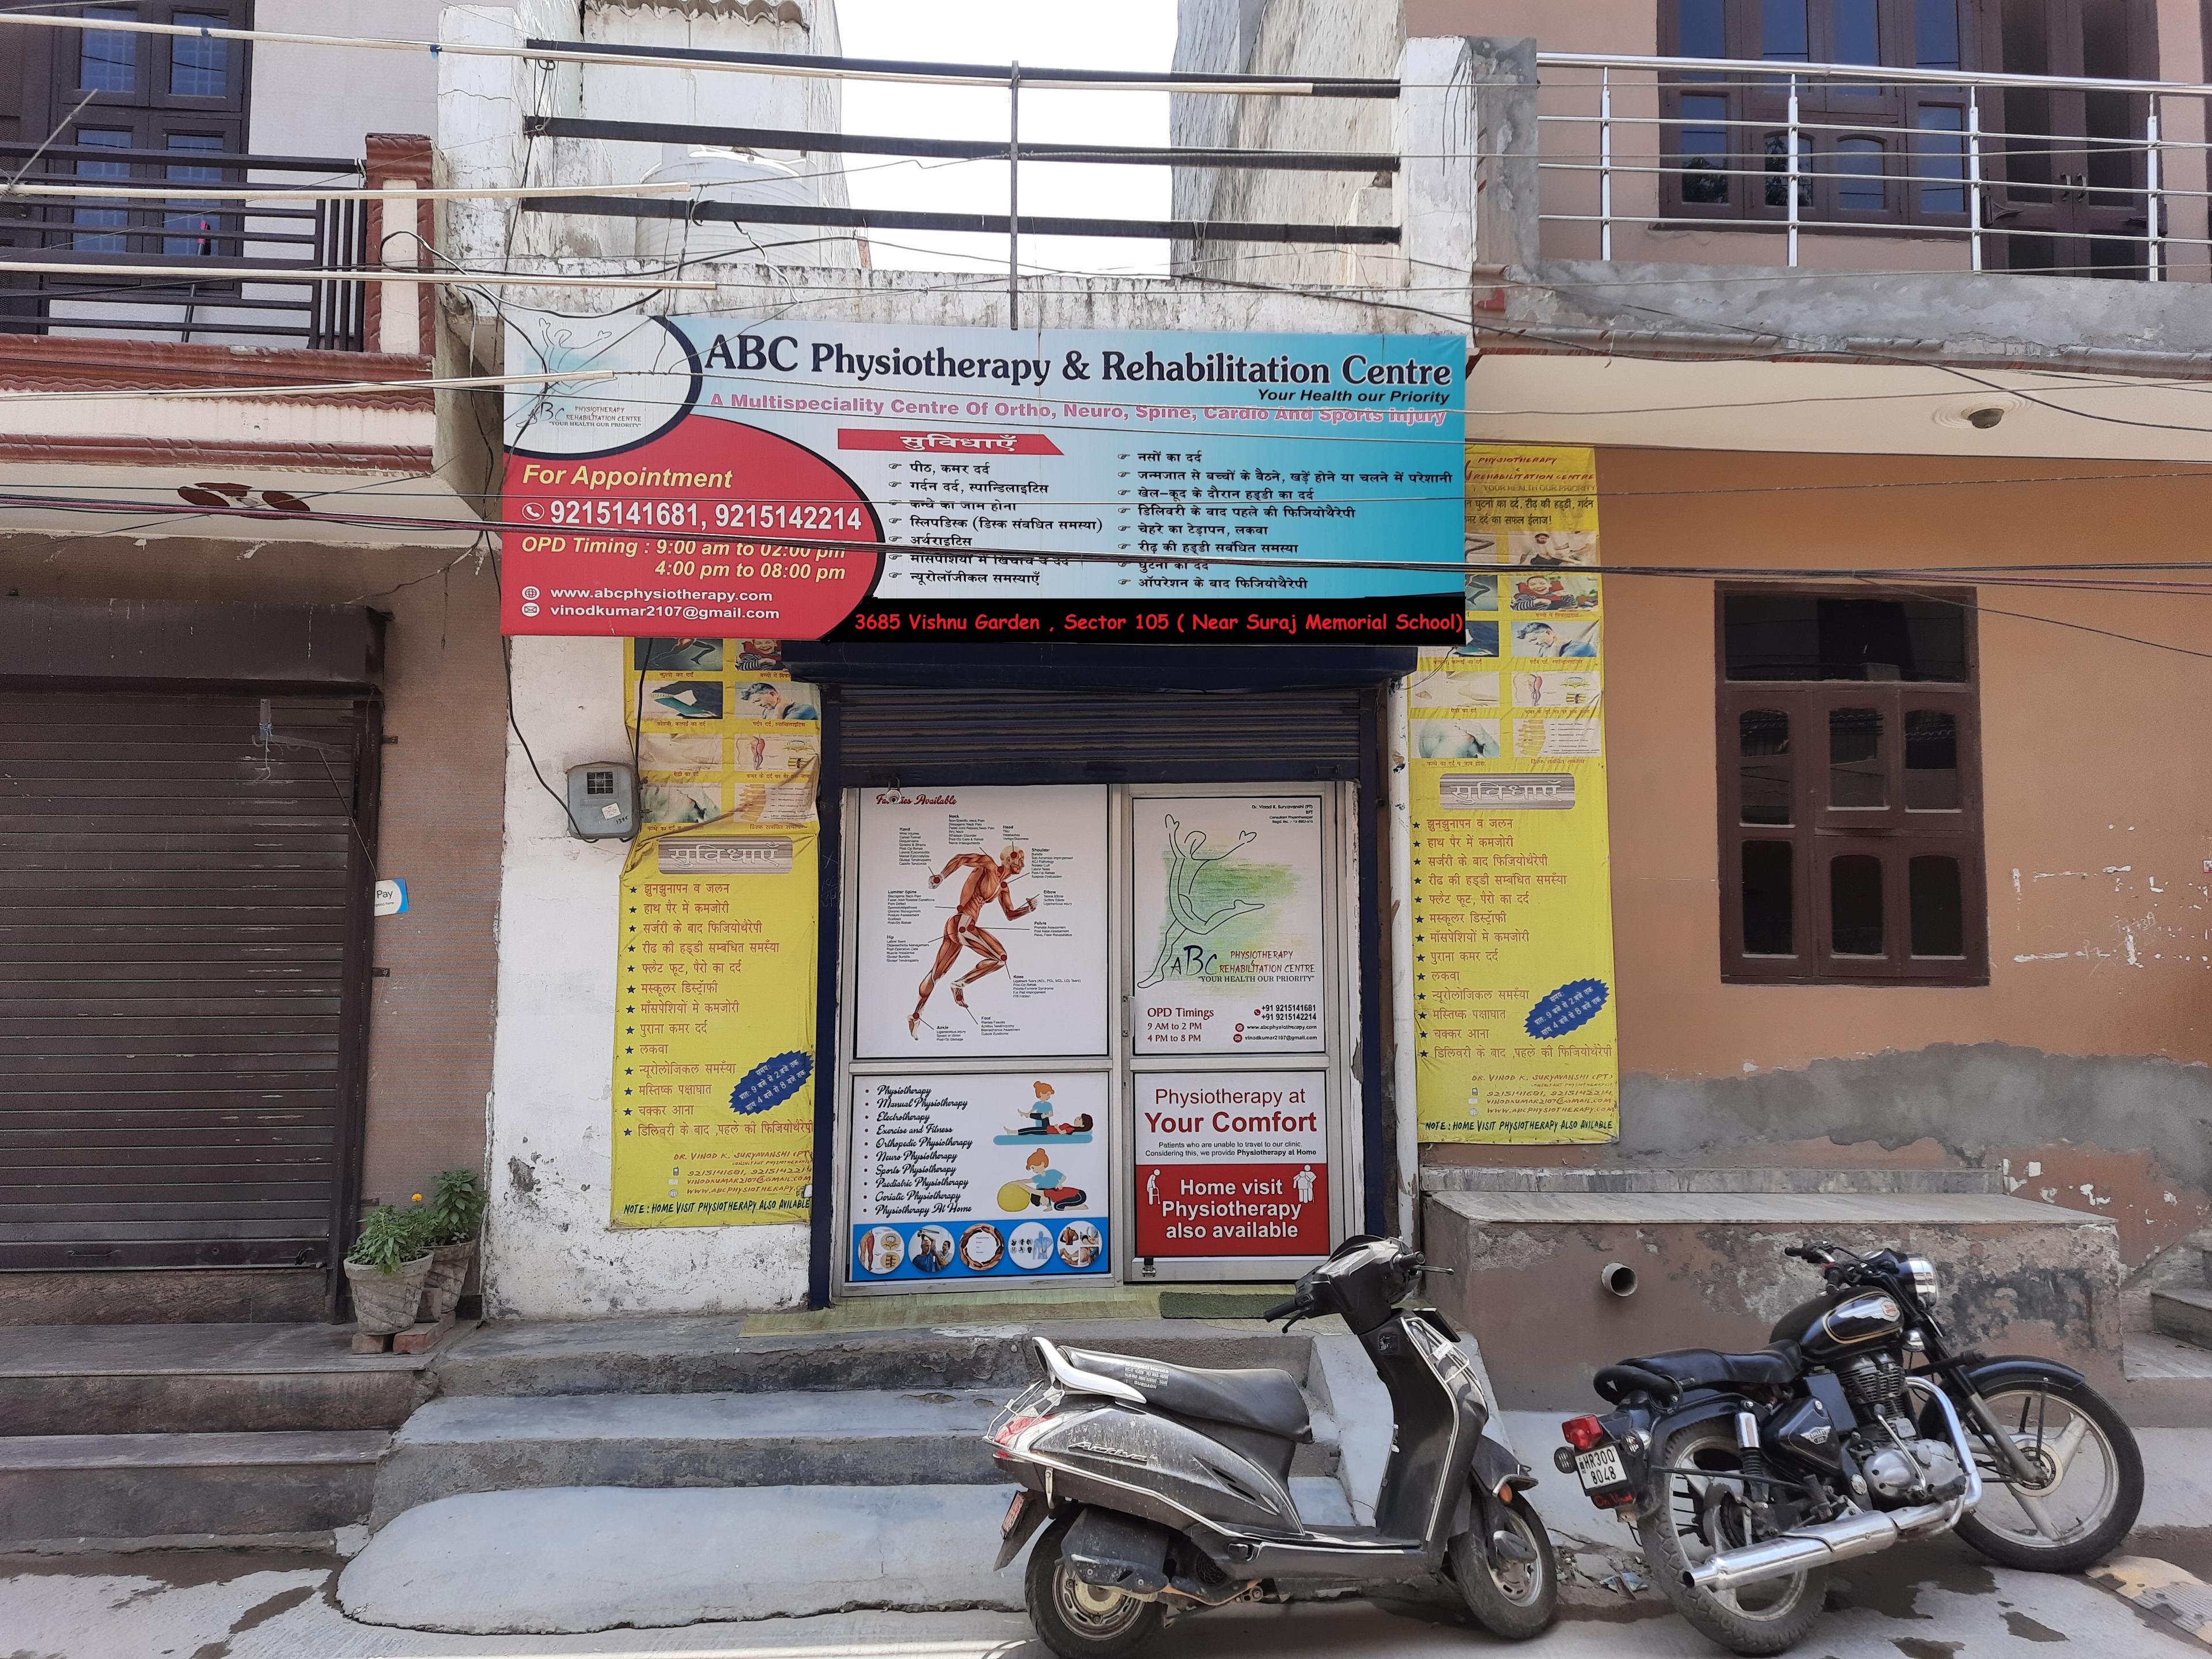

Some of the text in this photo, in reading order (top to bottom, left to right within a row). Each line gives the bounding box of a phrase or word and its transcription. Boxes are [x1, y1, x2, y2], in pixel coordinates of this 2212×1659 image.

[704, 334, 1452, 386] ABC Physiotherapy & Rehabilitation Centre
[1259, 389, 1450, 405] Your Health our Priority
[711, 393, 724, 406] A
[732, 394, 884, 415] Multispeciality
[891, 400, 959, 414] Centre
[966, 402, 988, 415] Of
[995, 403, 1056, 419] Ortho,
[1064, 404, 1128, 420] Neuro,
[1136, 406, 1196, 421] Spine,
[1204, 407, 1268, 420] Cardio
[1275, 408, 1313, 421] And
[1319, 408, 1382, 424] Sports
[900, 434, 1018, 452] सुविधाएँ
[1138, 450, 1202, 463] नसों का दर्द
[1478, 456, 1557, 464] PHYSIOTHERAPY
[910, 462, 990, 475] पीठ, कमर दर्द
[522, 464, 732, 490] For Appointment
[911, 480, 937, 492] गर्दन
[942, 480, 964, 494] दर्द,
[551, 501, 861, 531] 9215141681, 9215142214
[522, 537, 565, 553] OPD
[573, 537, 638, 556] Timing
[656, 539, 696, 555] 9:00
[702, 544, 729, 555] am
[736, 543, 755, 556] to
[760, 544, 811, 556] 02:00
[816, 548, 845, 561] pm
[655, 562, 845, 582] 4:00 pm to 08:00 pm
[551, 588, 772, 603] www.abcphysiotherapy.com
[551, 605, 779, 619] vinodkumar2107@gmail.com
[914, 794, 956, 805] Available
[377, 891, 393, 899] Pay
[1230, 950, 1293, 960] PHYSIOTHERAPY
[1219, 964, 1315, 974] REHABILITATION CENTRE
[1147, 1008, 1214, 1020] OPD Timings
[1532, 1074, 1589, 1082] SURYAVANSHI
[877, 1085, 931, 1098] Physiotherapy
[1156, 1088, 1305, 1108] Physiotherapy at
[877, 1098, 968, 1110] Manual Physiotherapy
[877, 1112, 930, 1124] Electrotherapy
[1145, 1111, 1317, 1133] Your Comfort
[1180, 1179, 1283, 1195] Home visit
[624, 1204, 645, 1214] NOTE
[652, 1203, 673, 1214] HOME
[676, 1202, 696, 1214] VISIT
[698, 1200, 756, 1215] PHYSIOTHERAPY
[759, 1200, 775, 1209] ALSO
[779, 1199, 810, 1209] AVILABLE
[876, 1203, 972, 1218] Physiotherapy At Home
[1162, 1200, 1301, 1221] Physiotherapy
[1166, 1221, 1298, 1238] also available
[1591, 1466, 1616, 1484] 8048
